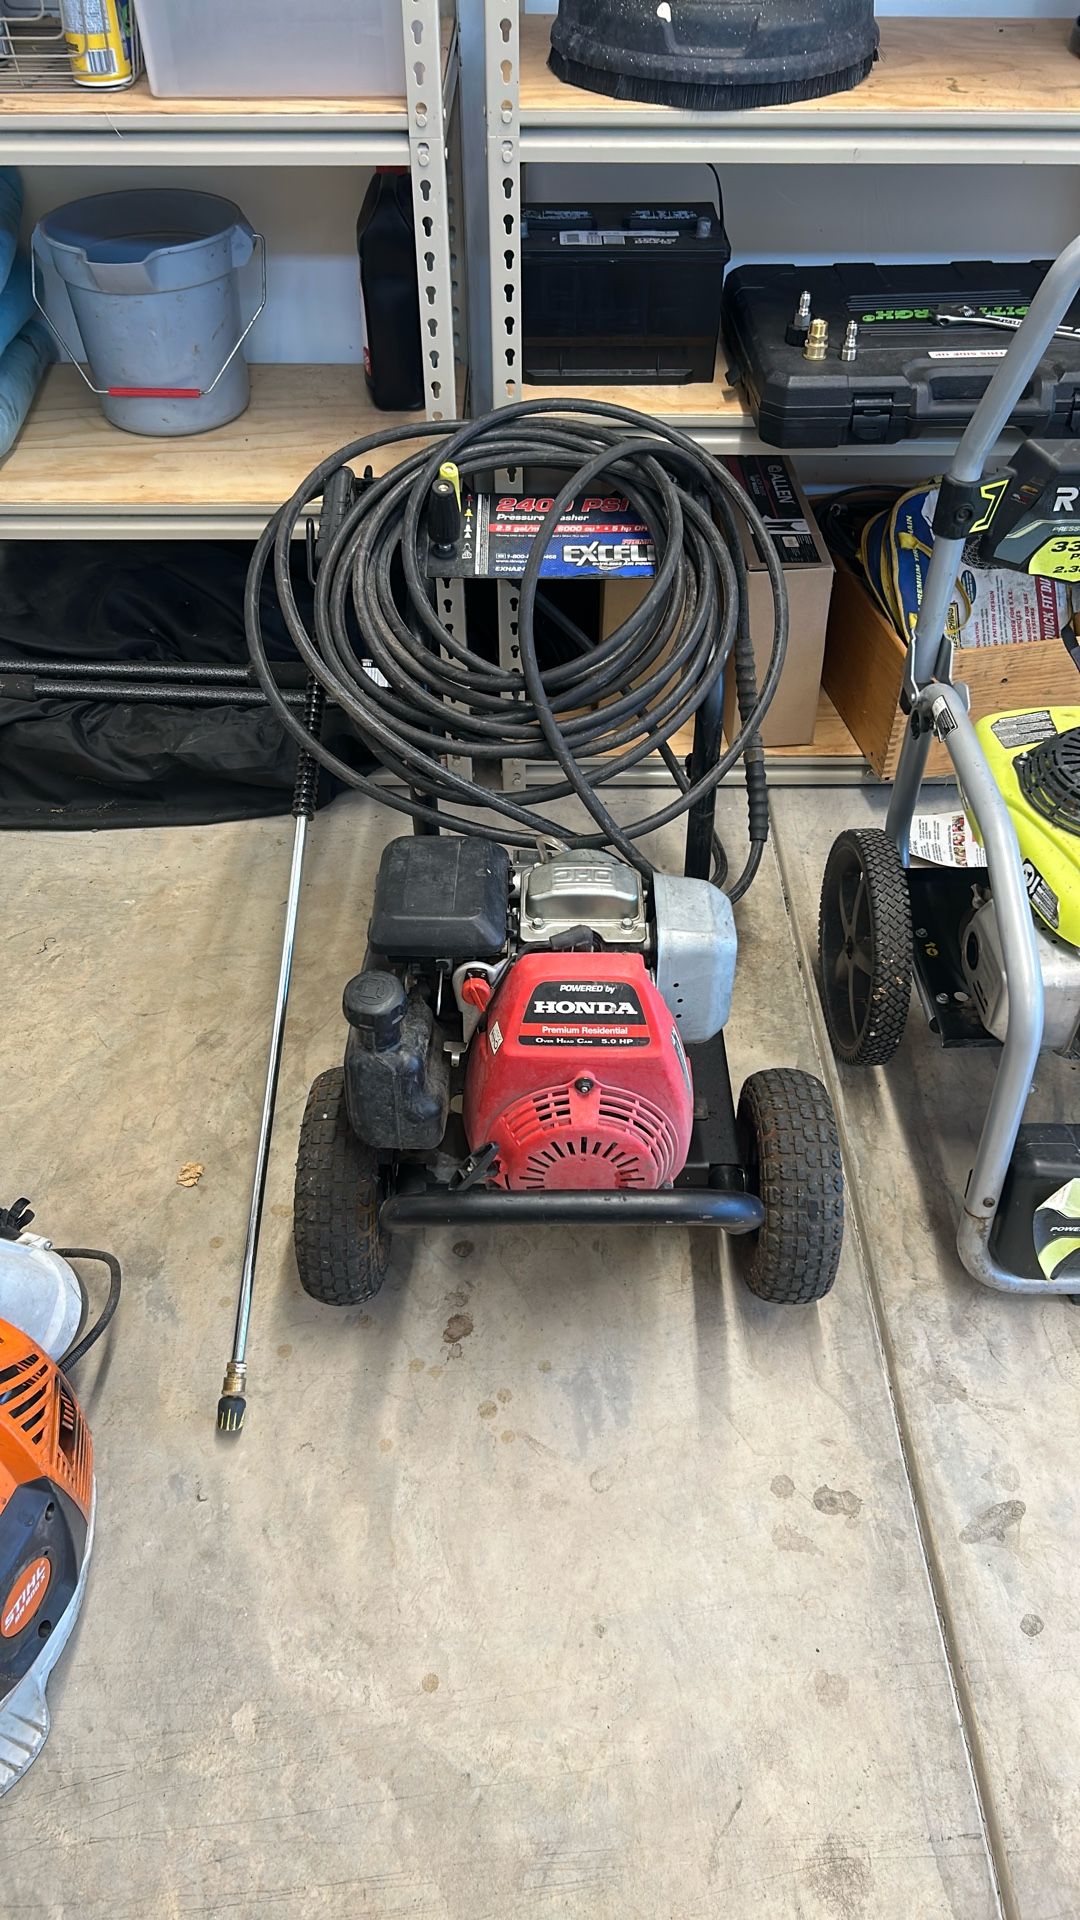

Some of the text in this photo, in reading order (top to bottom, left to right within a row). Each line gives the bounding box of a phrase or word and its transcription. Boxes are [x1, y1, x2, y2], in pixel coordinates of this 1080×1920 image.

[581, 498, 629, 512] PSI
[1053, 487, 1080, 511] R
[497, 513, 589, 521] Pressure asher
[514, 525, 541, 533] gal/m
[1052, 566, 1080, 574] 2.3
[1042, 592, 1054, 610] FIT
[560, 984, 616, 994] POWERED by
[533, 1001, 639, 1015] HONDA
[542, 1025, 628, 1035] Premium Residential
[5, 1566, 45, 1631] STIHL
